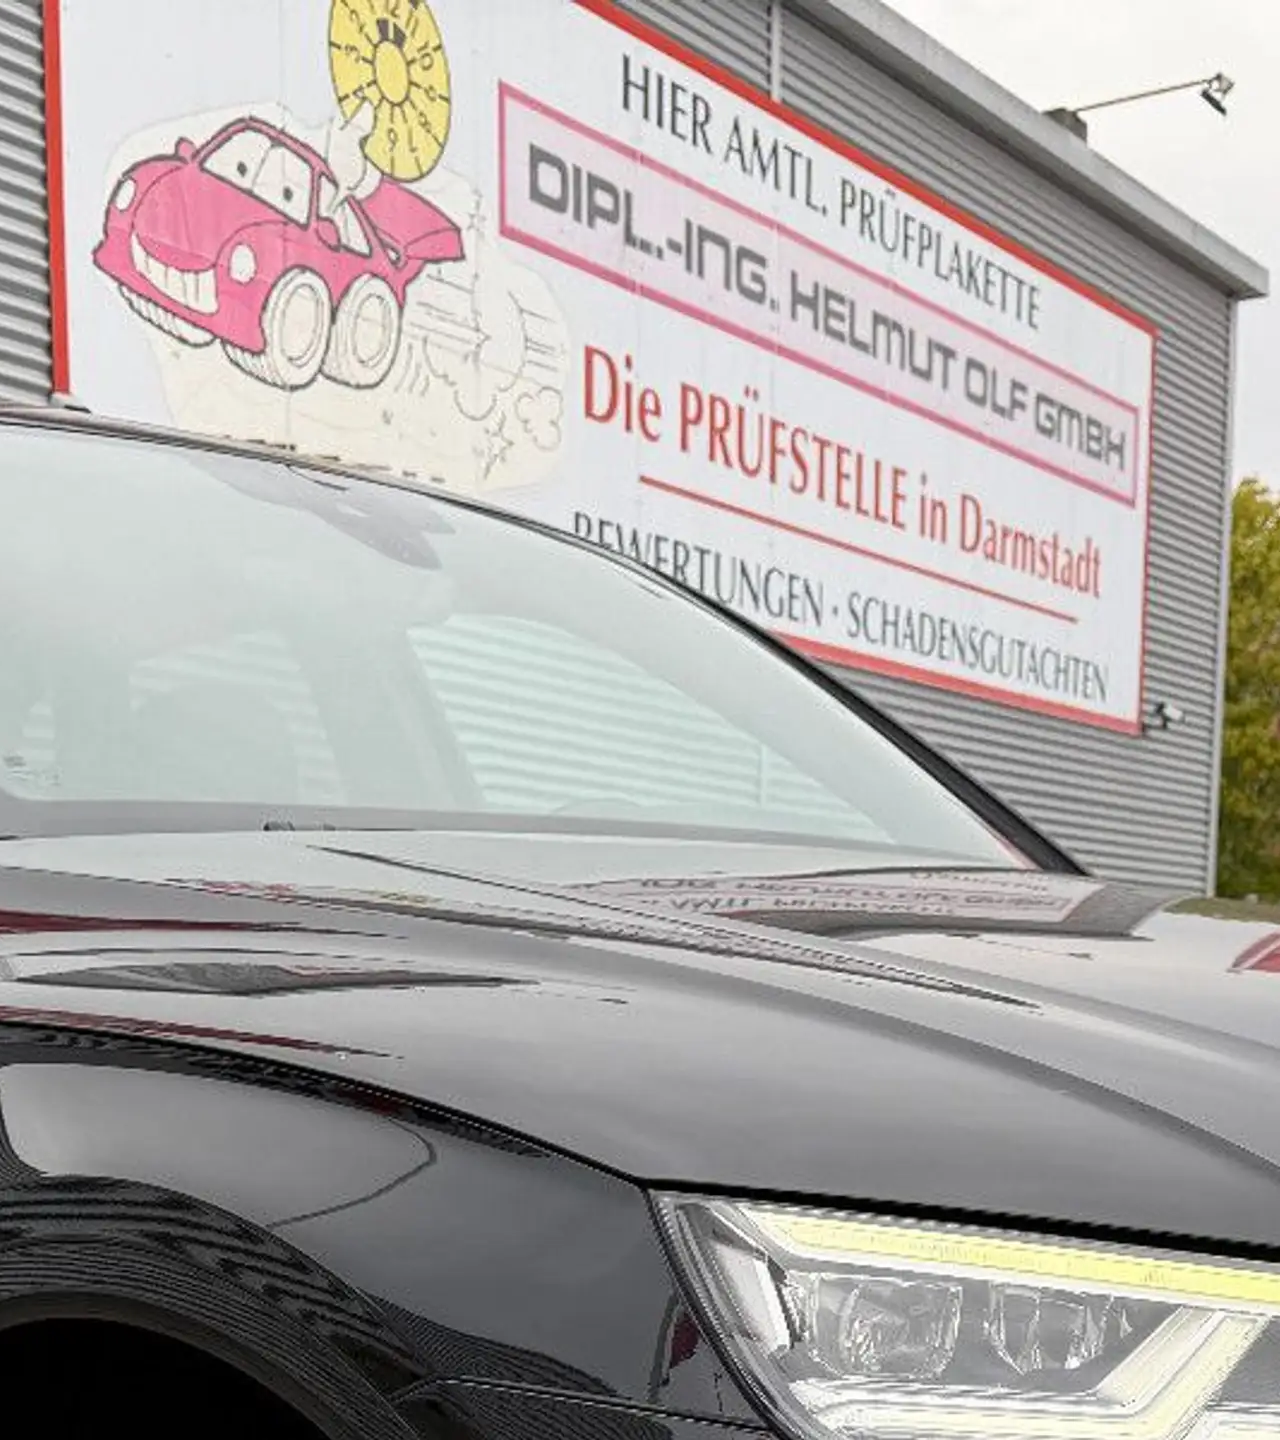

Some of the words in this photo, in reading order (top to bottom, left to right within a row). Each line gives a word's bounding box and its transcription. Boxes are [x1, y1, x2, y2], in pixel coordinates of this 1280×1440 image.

[528, 142, 781, 311] DIPL.-ING.
[790, 269, 957, 390] HELMUT
[963, 359, 1029, 422] OLF
[1035, 392, 1127, 472] GMBH
[621, 53, 712, 155] HIER
[726, 116, 829, 217] AMTL.
[841, 177, 1042, 330] PRÜFPLAKETTE
[583, 345, 662, 443] Die
[679, 383, 907, 530] PRÜFSTELLE
[919, 473, 949, 543] in
[959, 494, 1103, 600] Darmstadt
[846, 592, 1109, 703] SCHADENSGUTACHTEN
